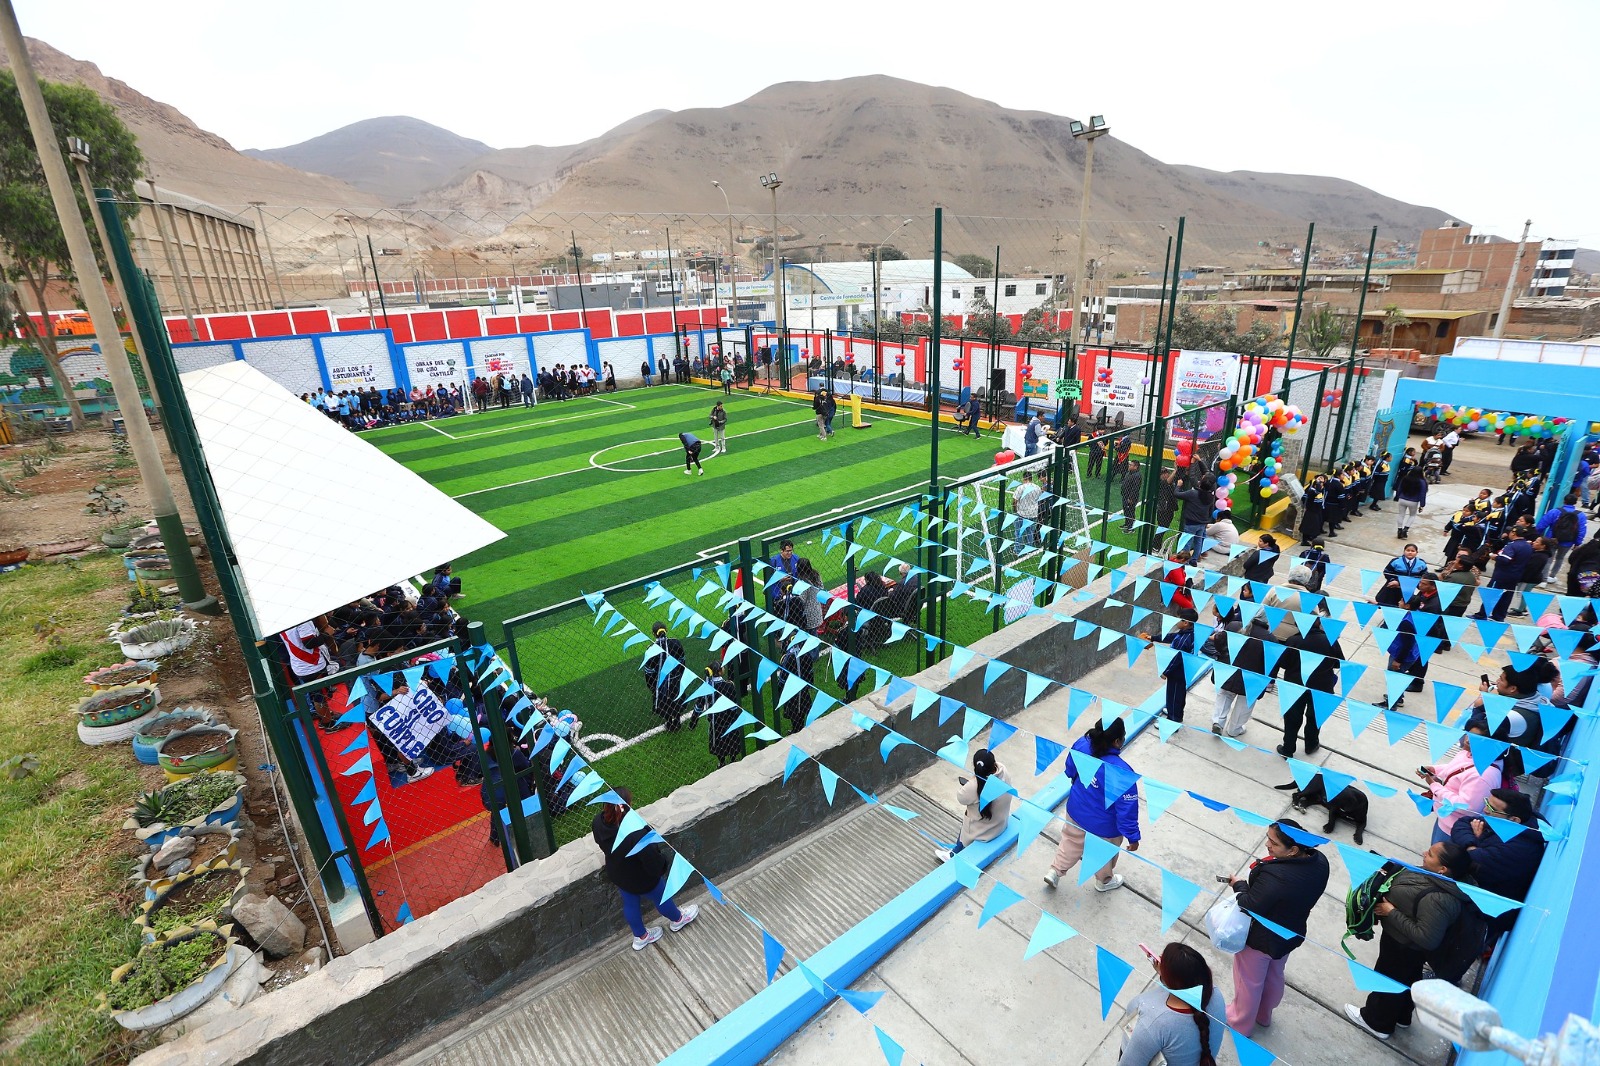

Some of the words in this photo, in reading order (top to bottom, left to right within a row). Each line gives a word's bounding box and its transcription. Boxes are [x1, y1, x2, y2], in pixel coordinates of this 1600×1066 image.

[332, 371, 370, 379] ESTUDIANTES
[1181, 381, 1227, 391] CUMPLIDA
[413, 689, 444, 724] CIRO
[405, 709, 420, 728] SI
[376, 706, 424, 759] CUMPLE
